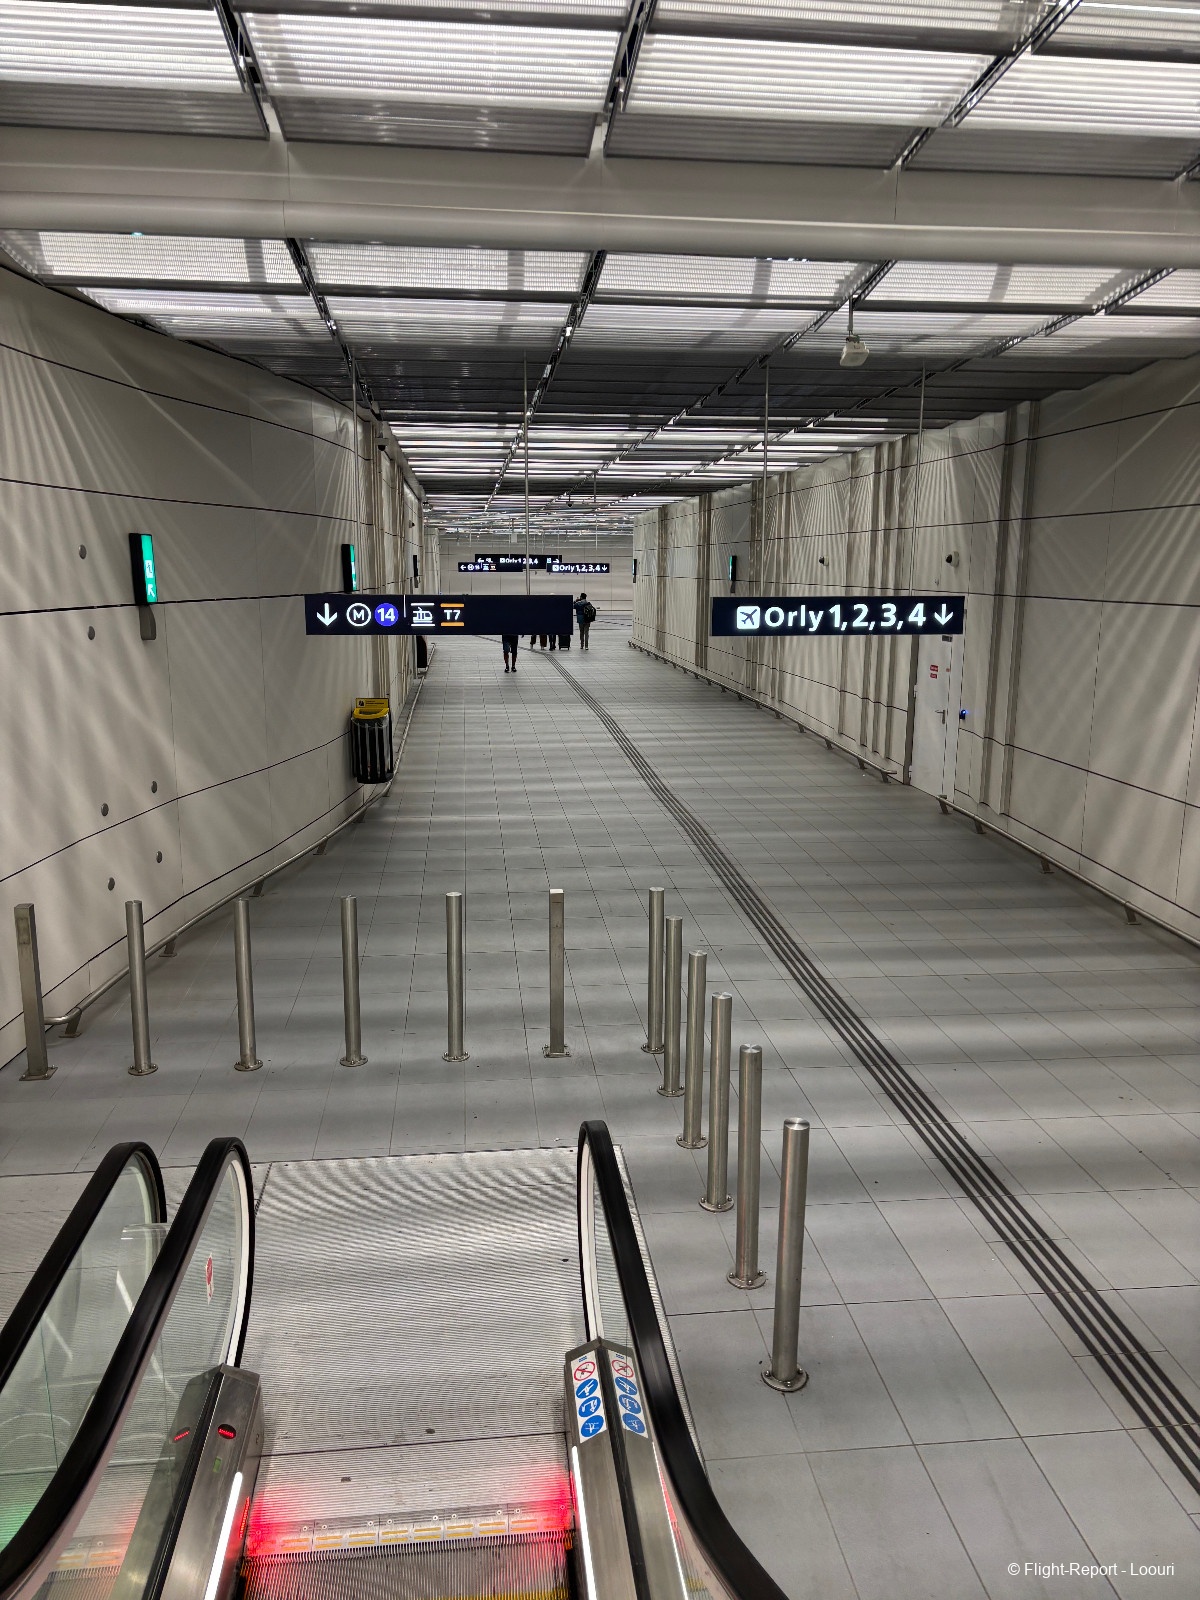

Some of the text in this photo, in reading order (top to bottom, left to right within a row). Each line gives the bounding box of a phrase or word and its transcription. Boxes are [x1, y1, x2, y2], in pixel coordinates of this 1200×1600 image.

[560, 564, 575, 572] Orly
[377, 607, 396, 622] 14
[443, 609, 461, 621] T7
[764, 604, 824, 632] Orly
